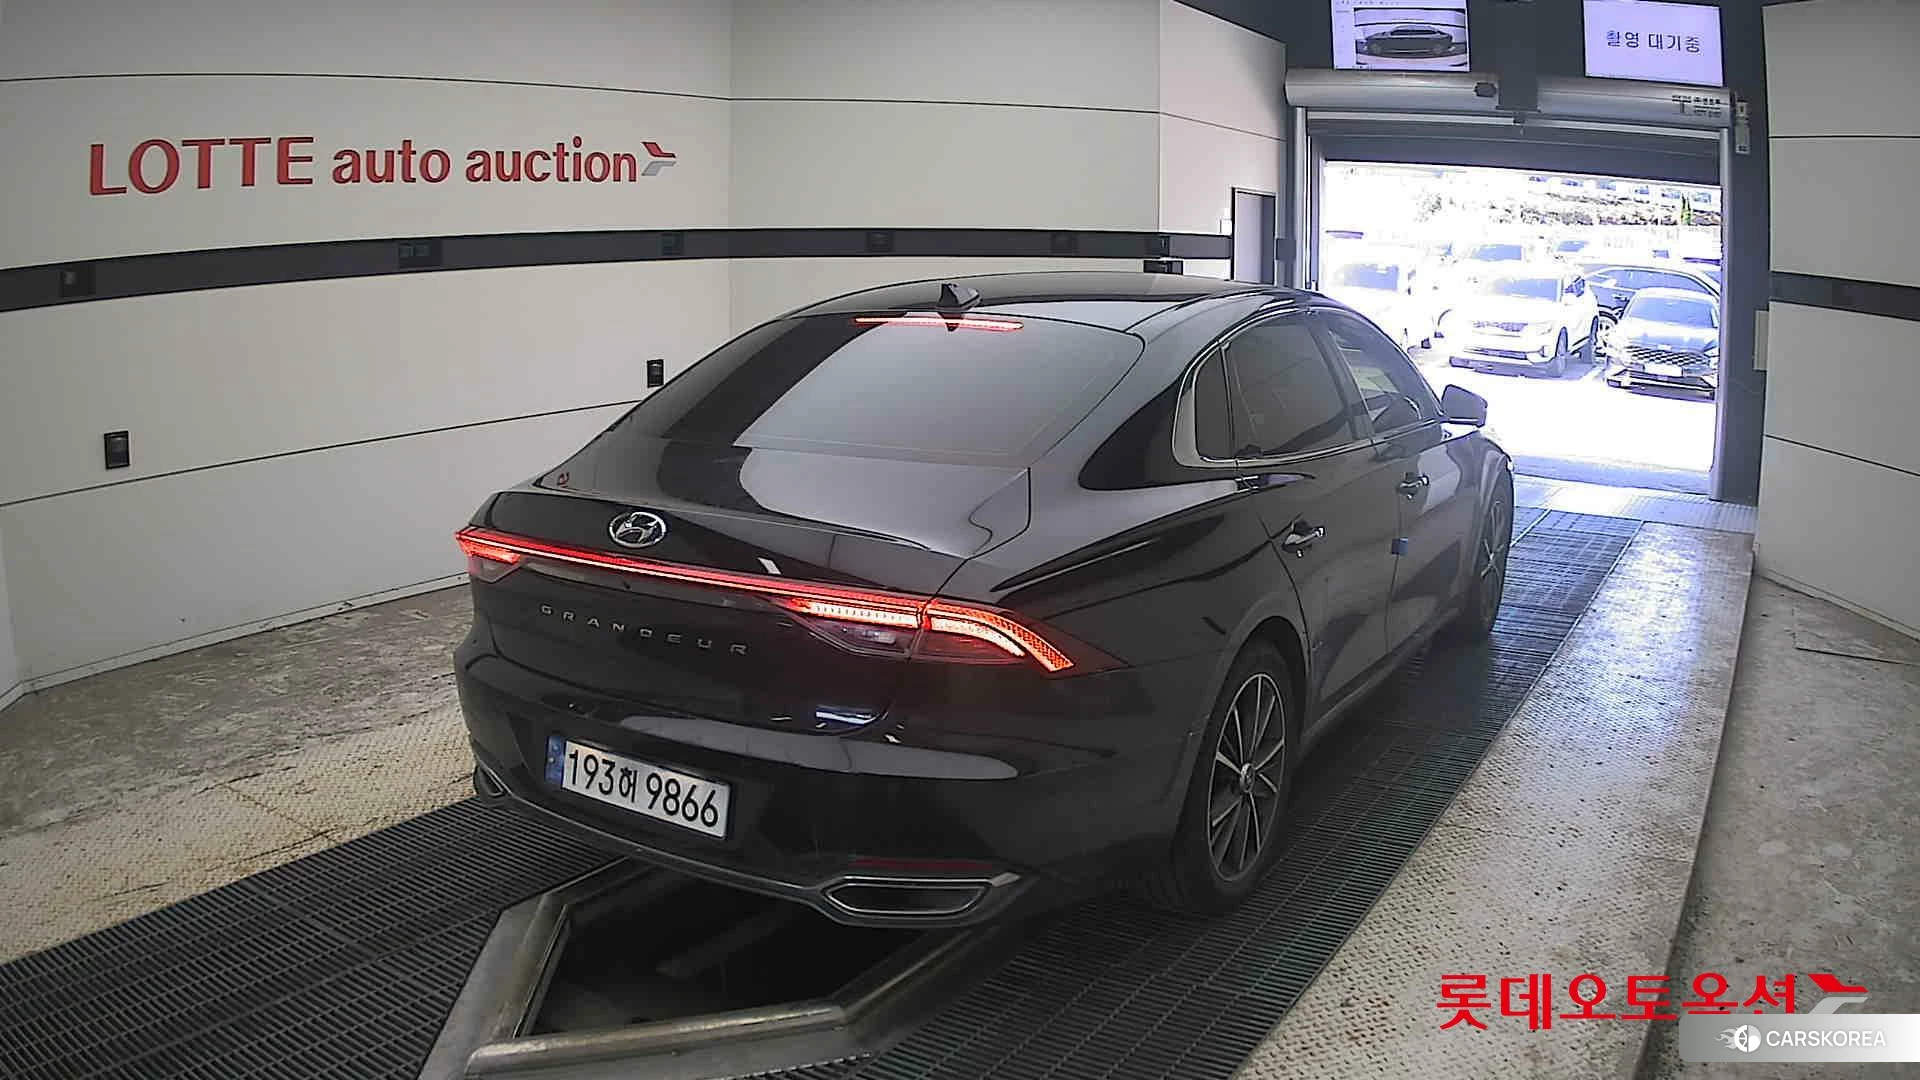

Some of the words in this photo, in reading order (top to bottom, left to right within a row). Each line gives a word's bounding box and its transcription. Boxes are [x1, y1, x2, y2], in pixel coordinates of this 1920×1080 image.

[90, 137, 314, 196] LOTTE
[332, 140, 451, 184] auto
[466, 136, 638, 183] auction
[541, 605, 747, 655] GRANDEUR
[569, 749, 638, 803] 193허
[646, 772, 719, 827] 9866
